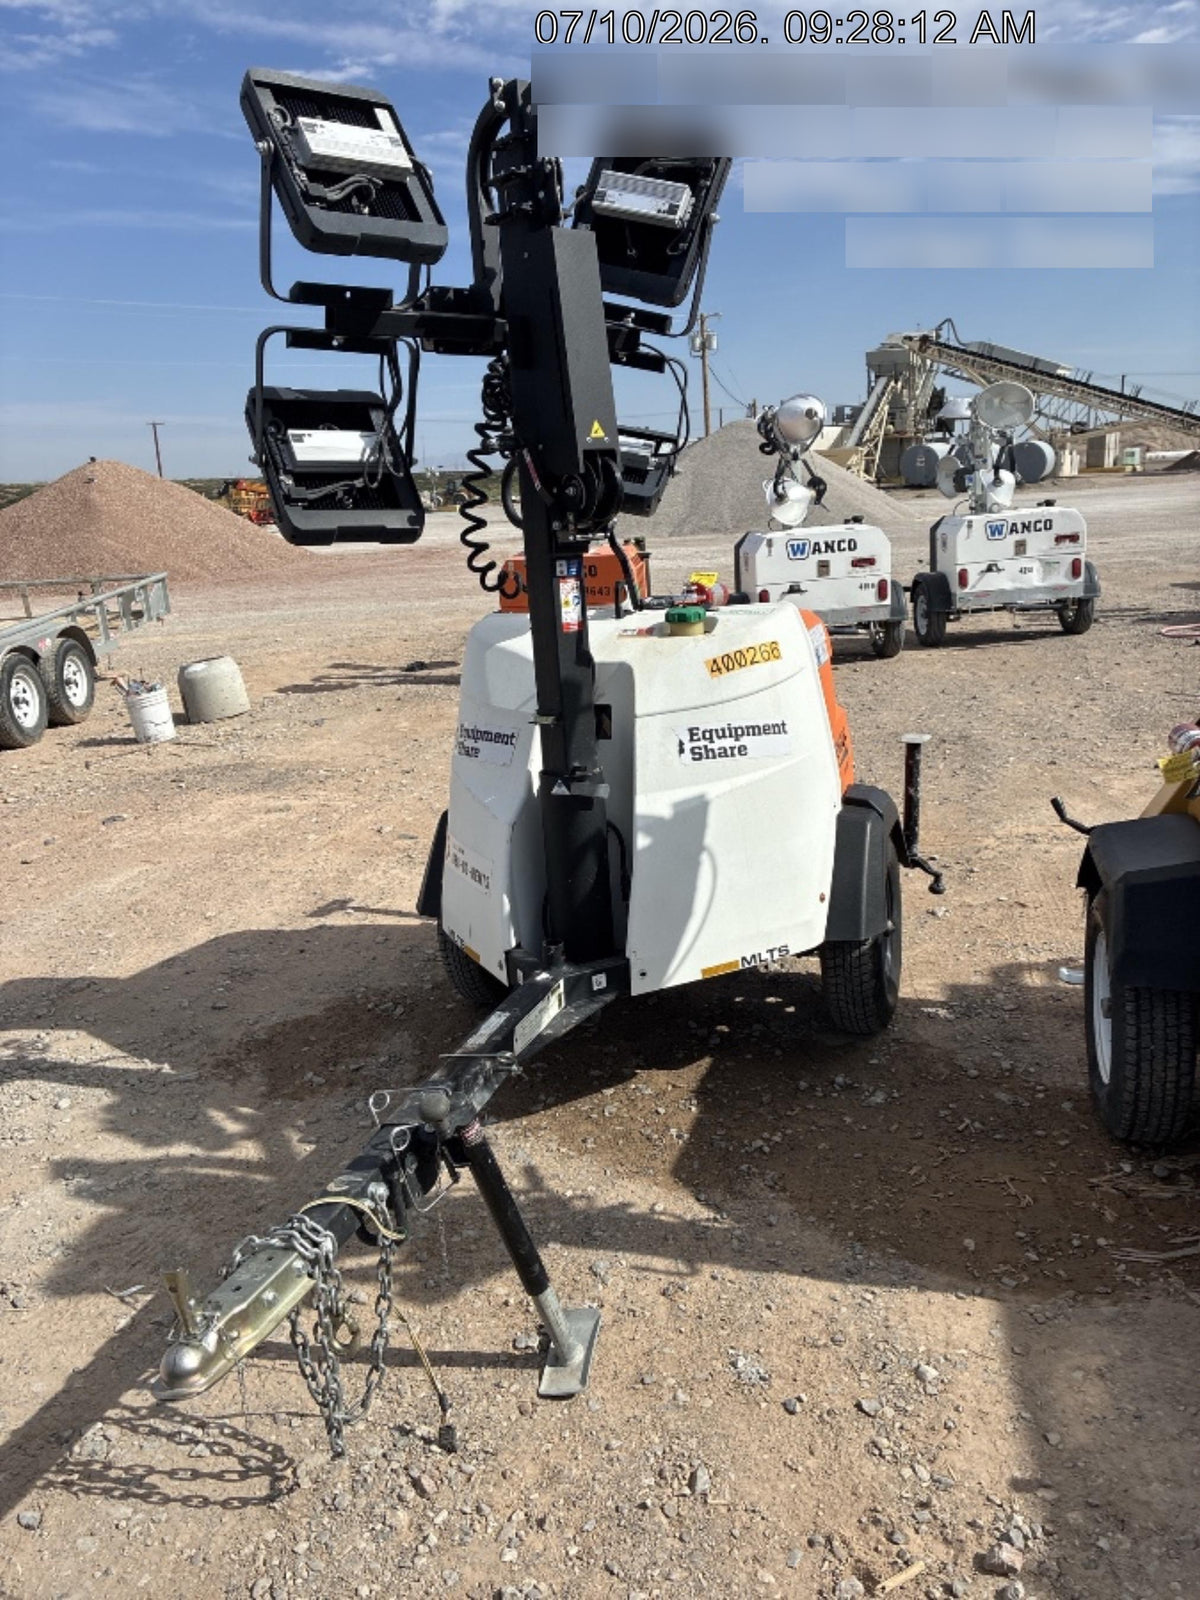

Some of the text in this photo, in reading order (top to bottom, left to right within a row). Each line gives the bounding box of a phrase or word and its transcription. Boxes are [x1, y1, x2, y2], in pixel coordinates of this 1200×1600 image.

[986, 518, 1053, 540] WANCO
[786, 538, 858, 560] WANCO
[710, 640, 781, 675] 400266
[687, 720, 788, 744] Equipment
[689, 744, 748, 761] Share
[740, 943, 790, 968] MLTS
